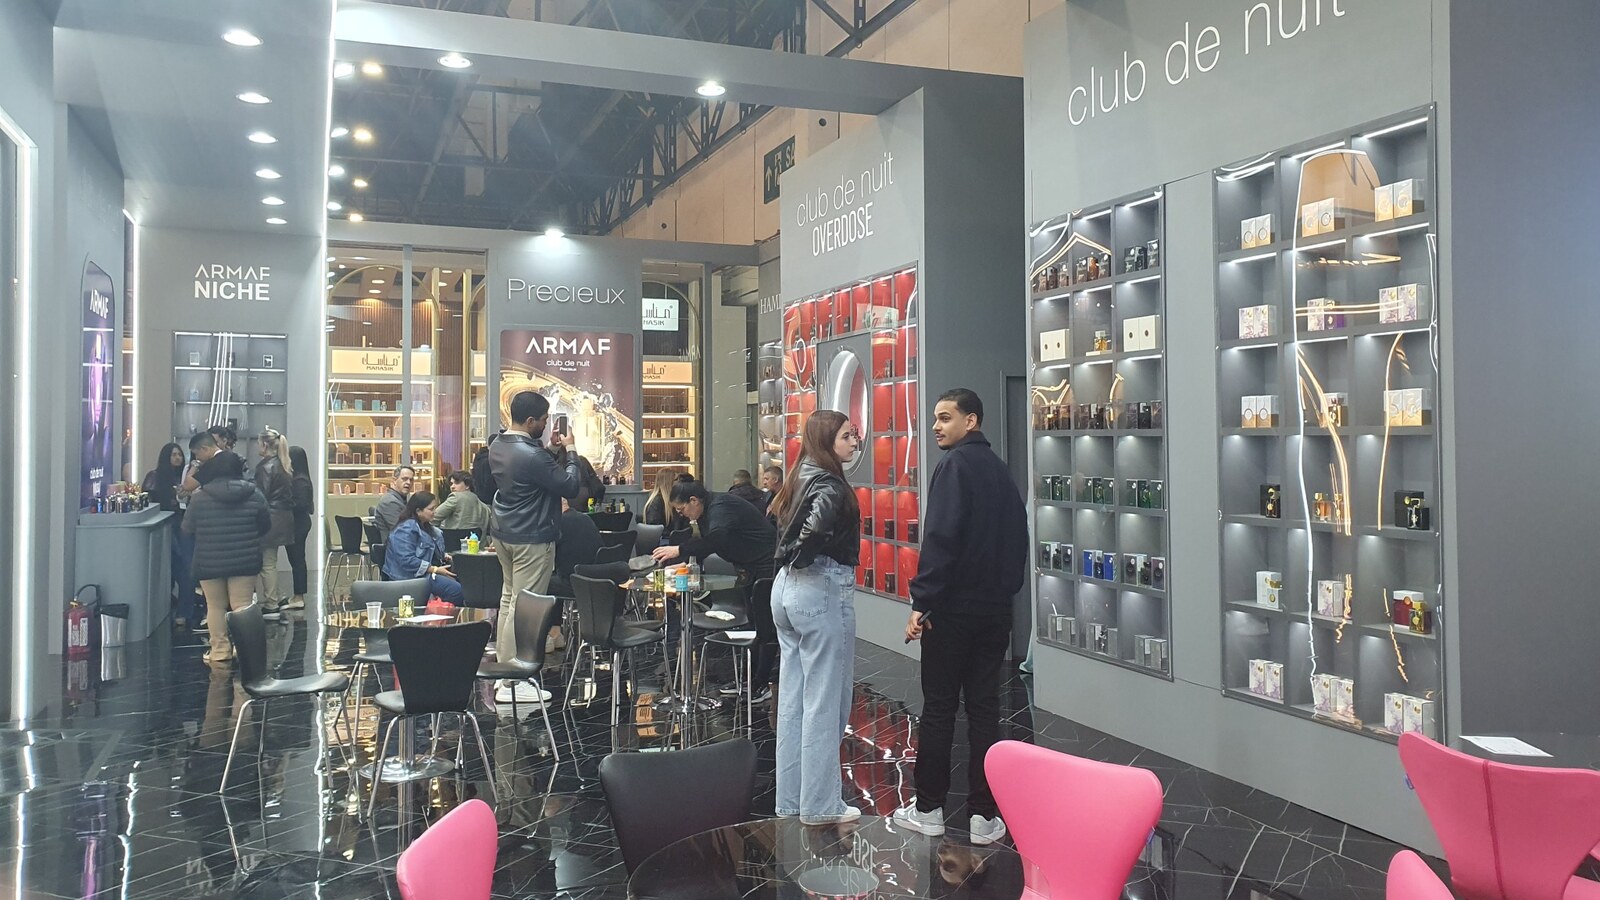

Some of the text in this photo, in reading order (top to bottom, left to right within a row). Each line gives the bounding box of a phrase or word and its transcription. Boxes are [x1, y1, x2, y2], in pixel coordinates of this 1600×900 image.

[1067, 0, 1346, 127] club de nu
[796, 151, 894, 227] club de nuit
[812, 201, 874, 257] OVERDOSE
[194, 263, 271, 281] ARMAF
[194, 280, 270, 301] NICHE
[507, 278, 625, 305] Precieux
[525, 336, 611, 356] ARMAF
[546, 359, 563, 367] club
[564, 359, 575, 367] de
